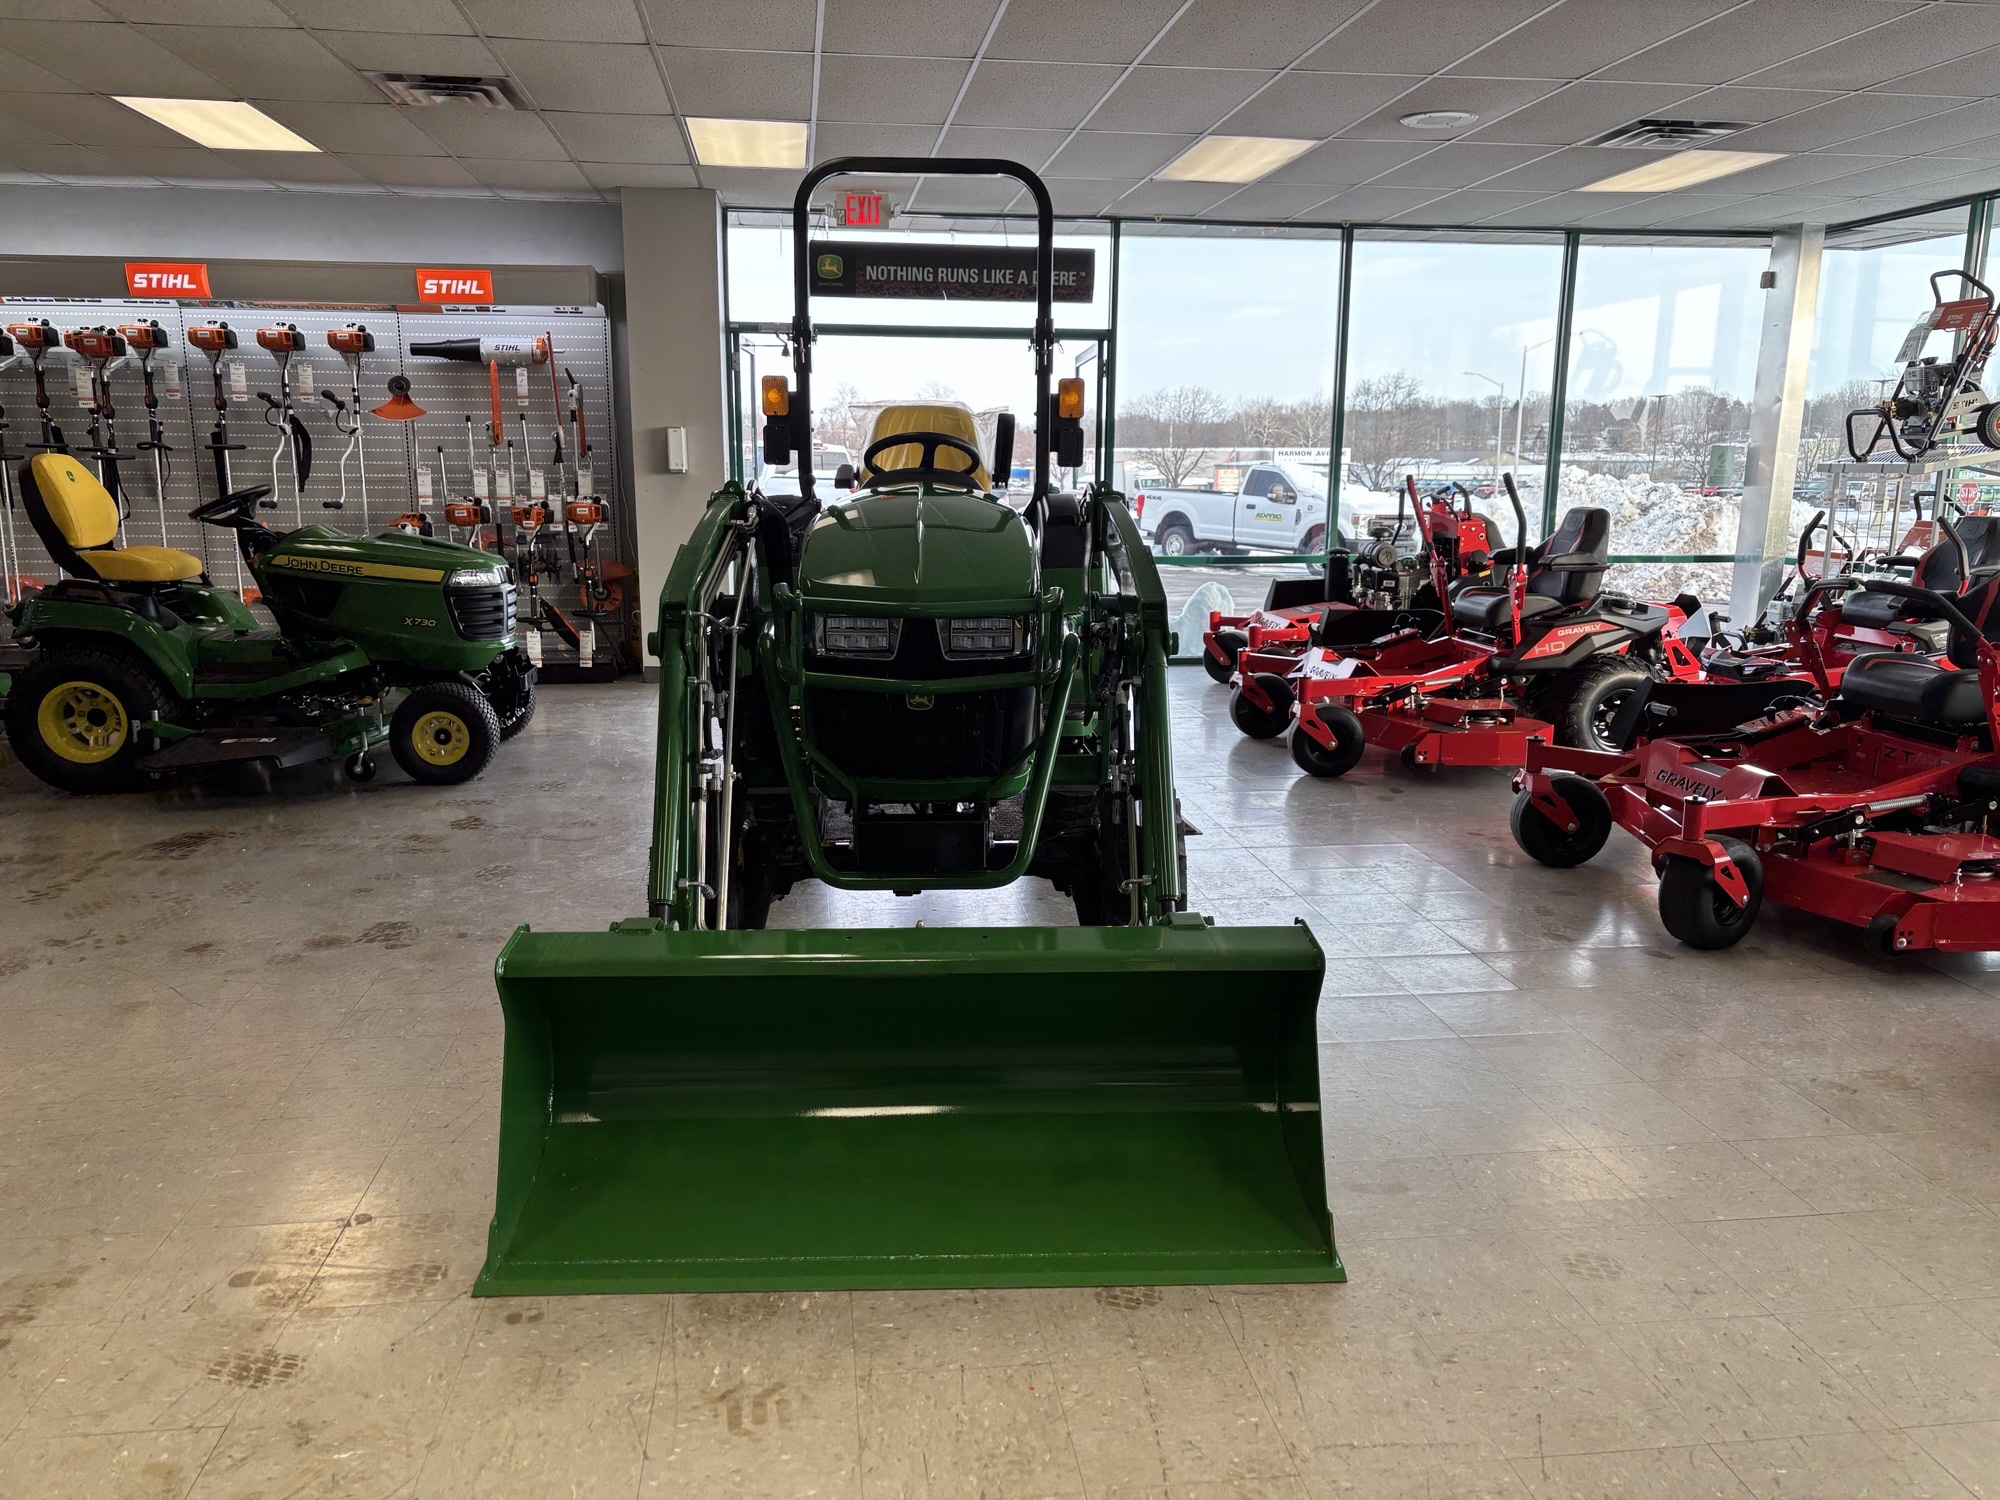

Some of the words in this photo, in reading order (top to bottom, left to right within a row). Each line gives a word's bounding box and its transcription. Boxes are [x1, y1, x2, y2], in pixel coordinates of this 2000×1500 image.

[846, 195, 882, 225] EXIT
[133, 273, 197, 289] STIHL
[866, 265, 933, 282] NOTHING
[938, 267, 979, 283] RUNS
[983, 269, 1014, 284] LIKE
[1018, 270, 1028, 285] A
[423, 279, 484, 294] STIHL
[494, 344, 521, 352] STIHL
[1960, 488, 1978, 498] STOP
[284, 556, 318, 571] JOHN
[320, 560, 364, 576] DEERE
[403, 616, 437, 627] X730
[1557, 624, 1601, 637] GRAVELY
[1535, 641, 1566, 655] HD
[1656, 769, 1723, 801] GRAVELY
